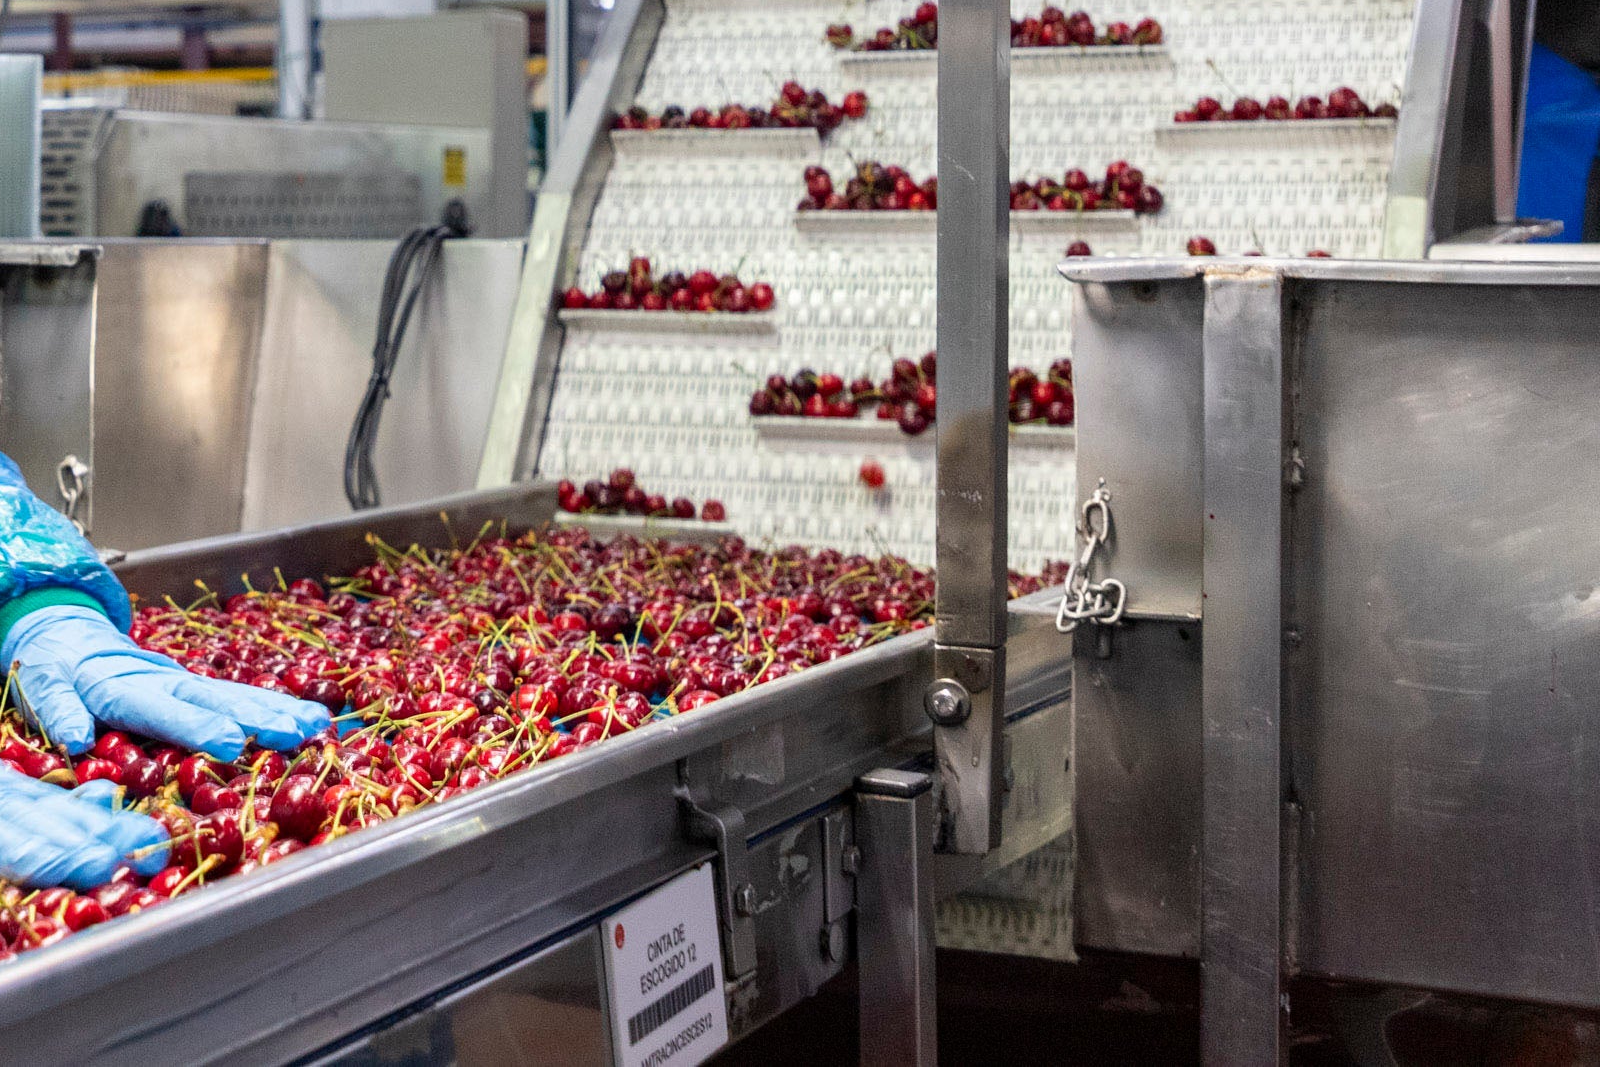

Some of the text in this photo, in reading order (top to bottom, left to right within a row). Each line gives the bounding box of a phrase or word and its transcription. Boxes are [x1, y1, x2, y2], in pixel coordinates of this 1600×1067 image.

[647, 923, 686, 962] CINTA DE
[640, 942, 697, 995] ESCOGIDO 12
